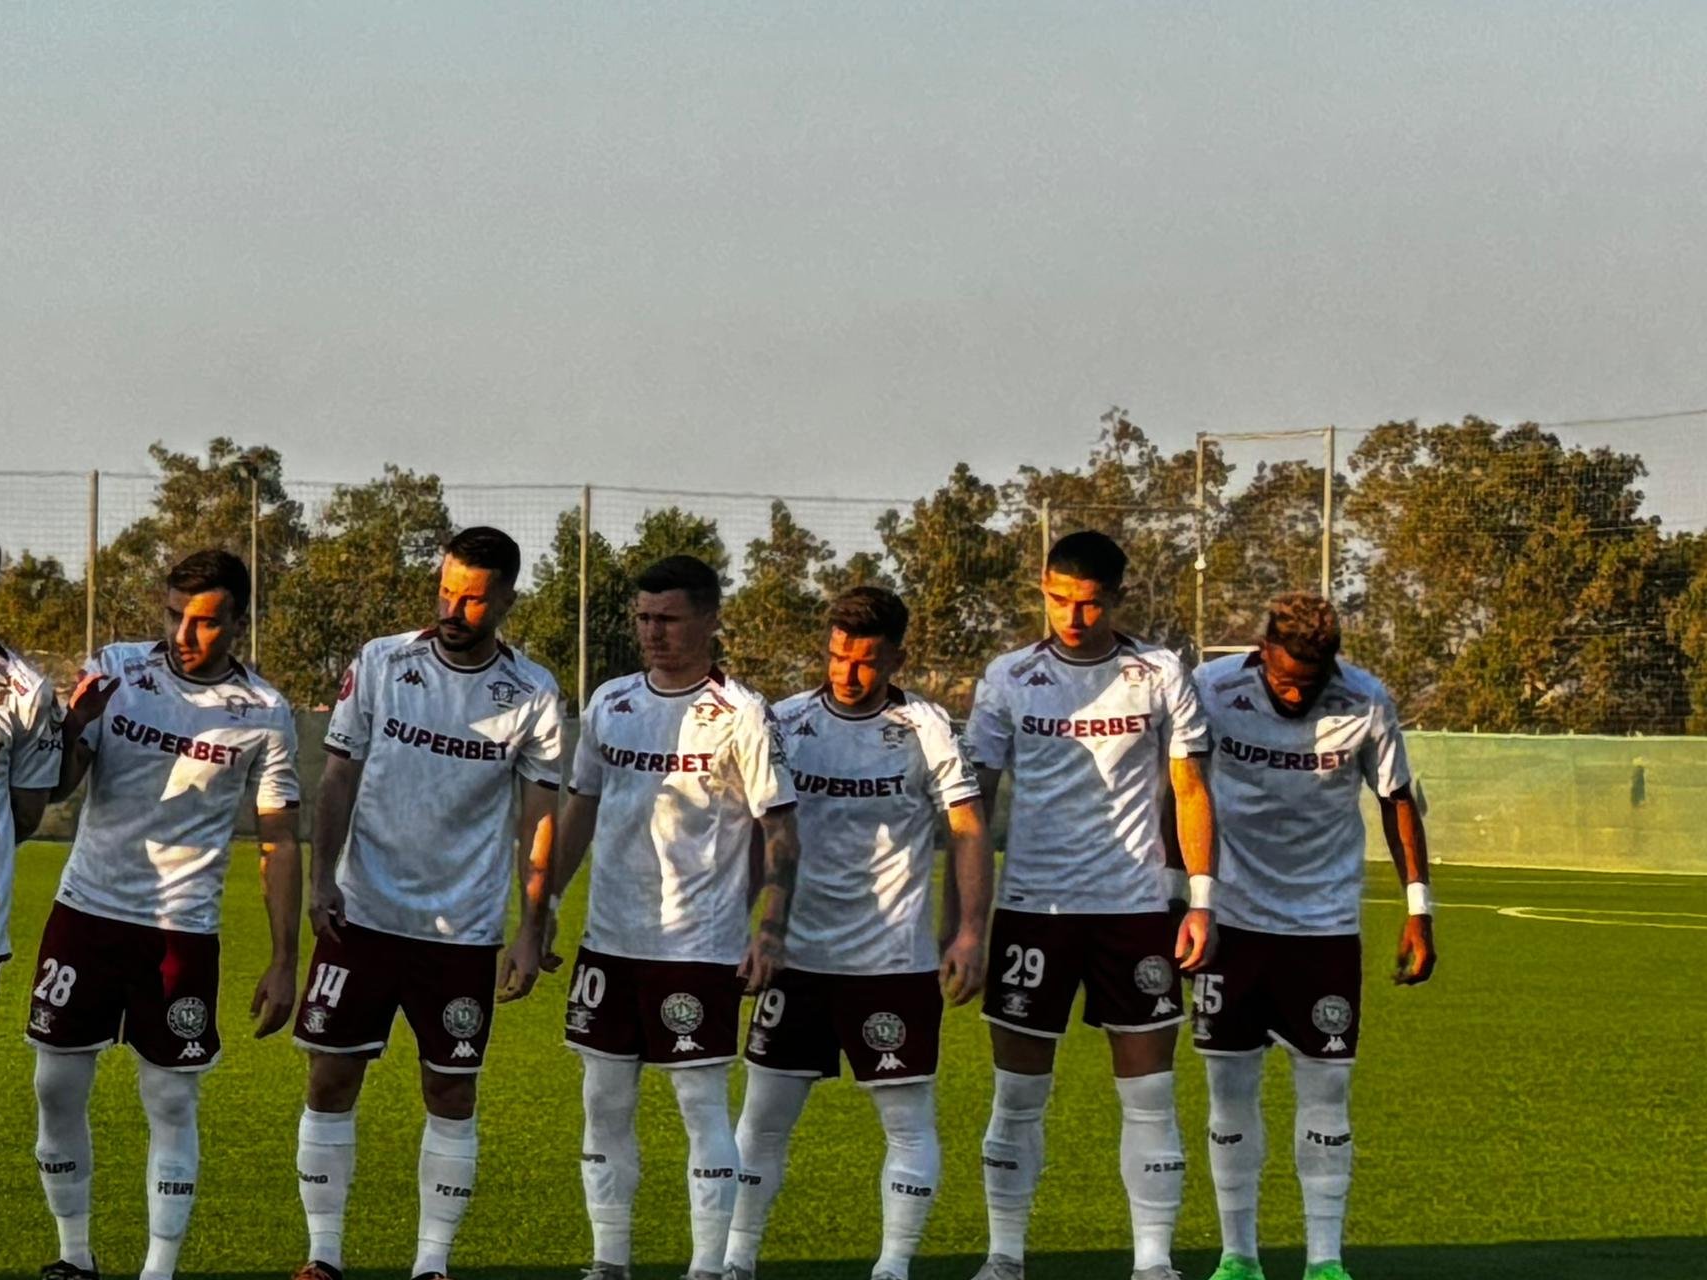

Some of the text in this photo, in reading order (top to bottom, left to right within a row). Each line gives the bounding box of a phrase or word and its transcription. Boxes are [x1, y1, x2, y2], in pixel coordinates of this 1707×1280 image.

[111, 714, 243, 766] SUPERBET
[383, 718, 509, 761] SUPERBET
[1021, 714, 1152, 738] SUPERBET
[1220, 736, 1350, 771] SUPERBET
[33, 958, 76, 1007] 28
[307, 962, 350, 1008] 14
[568, 964, 606, 1008] 10
[1001, 944, 1045, 988] 29
